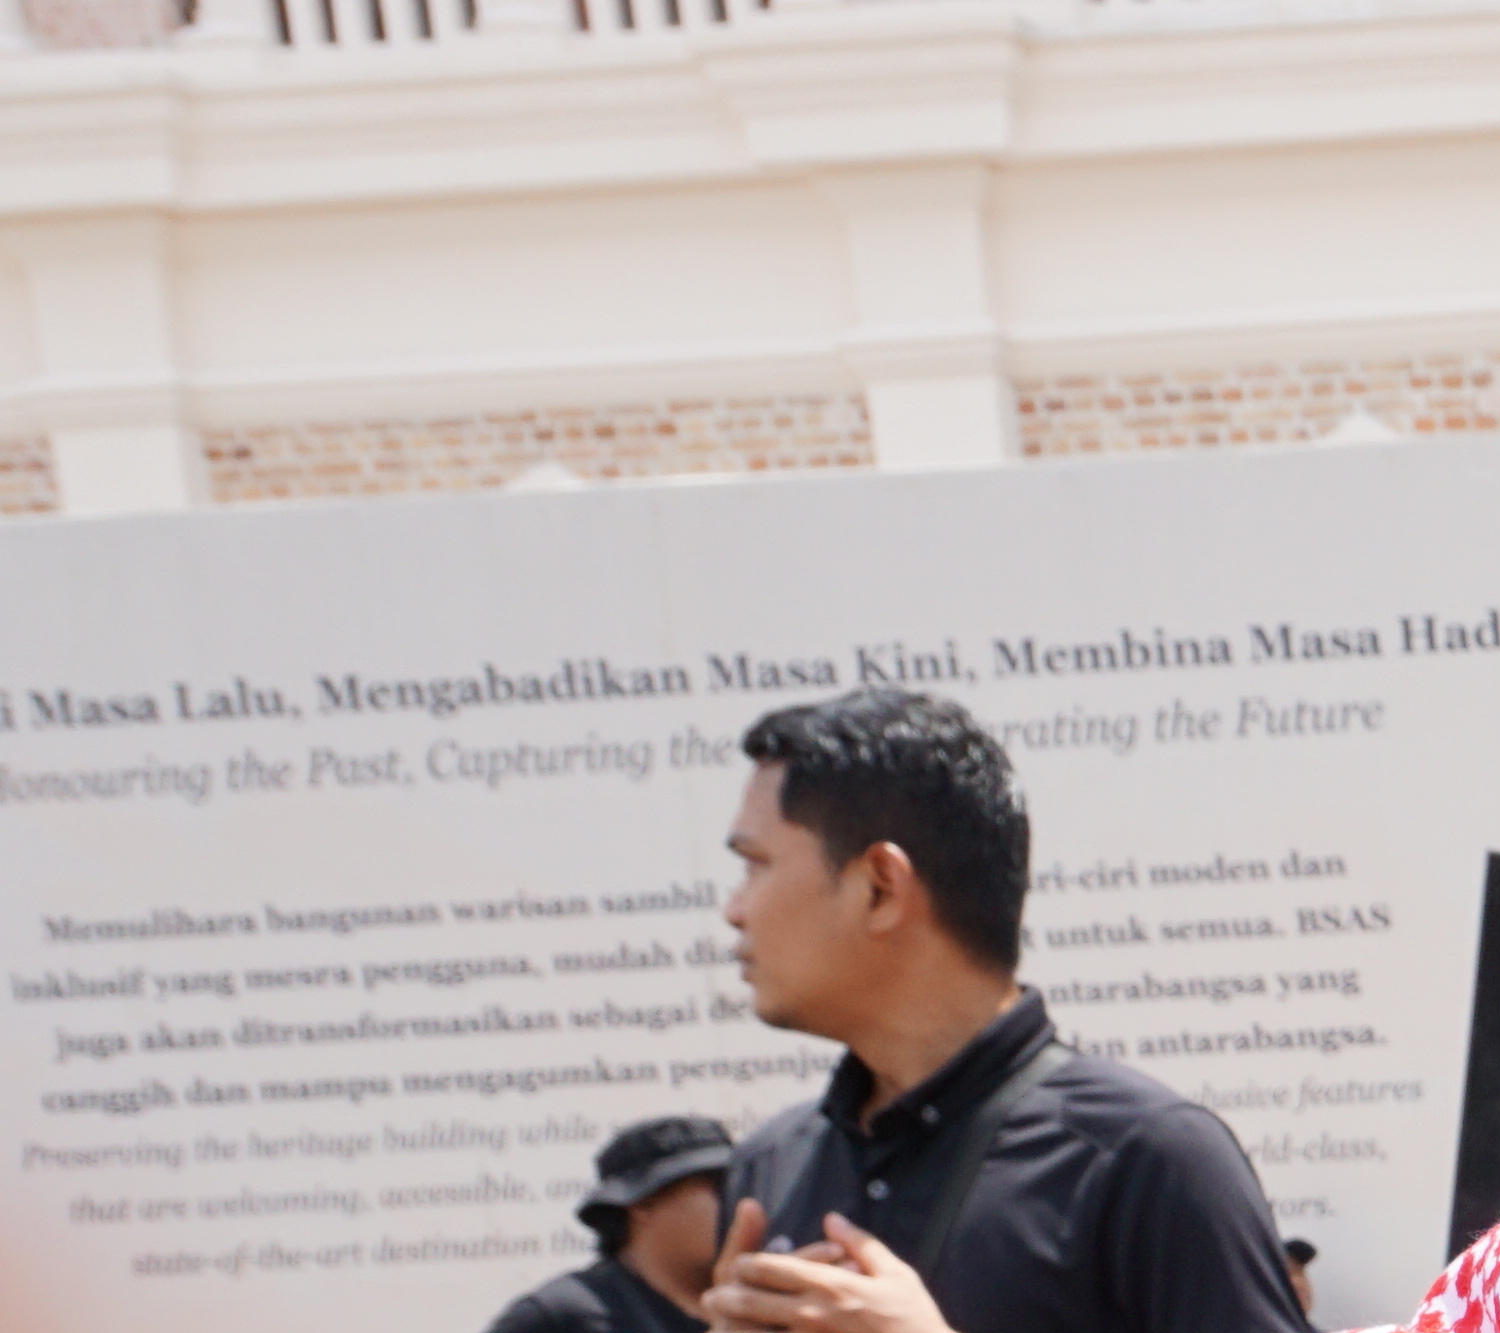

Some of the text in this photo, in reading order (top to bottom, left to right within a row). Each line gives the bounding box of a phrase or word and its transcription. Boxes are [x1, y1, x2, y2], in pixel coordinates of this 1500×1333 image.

[29, 686, 162, 732] Masa
[173, 675, 304, 724] Lalu,
[315, 656, 693, 718] Mengabadikan
[706, 652, 840, 693] Masa
[854, 639, 977, 684] Kini,
[993, 627, 1234, 677] Membina
[1248, 622, 1384, 665] Masa
[225, 748, 292, 792] the
[425, 732, 655, 791] Capturing
[668, 724, 736, 770] the
[1153, 698, 1224, 744] the
[1235, 696, 1386, 740] Future
[1150, 850, 1270, 886] moden
[1279, 847, 1347, 881] dan
[1045, 914, 1150, 950] untuk
[1159, 912, 1287, 945] semua.
[1048, 970, 1266, 1005] ntarabangsa
[1276, 966, 1362, 1001] yang
[668, 1045, 830, 1086] pengunju
[1137, 1022, 1388, 1061] antarabangsa.
